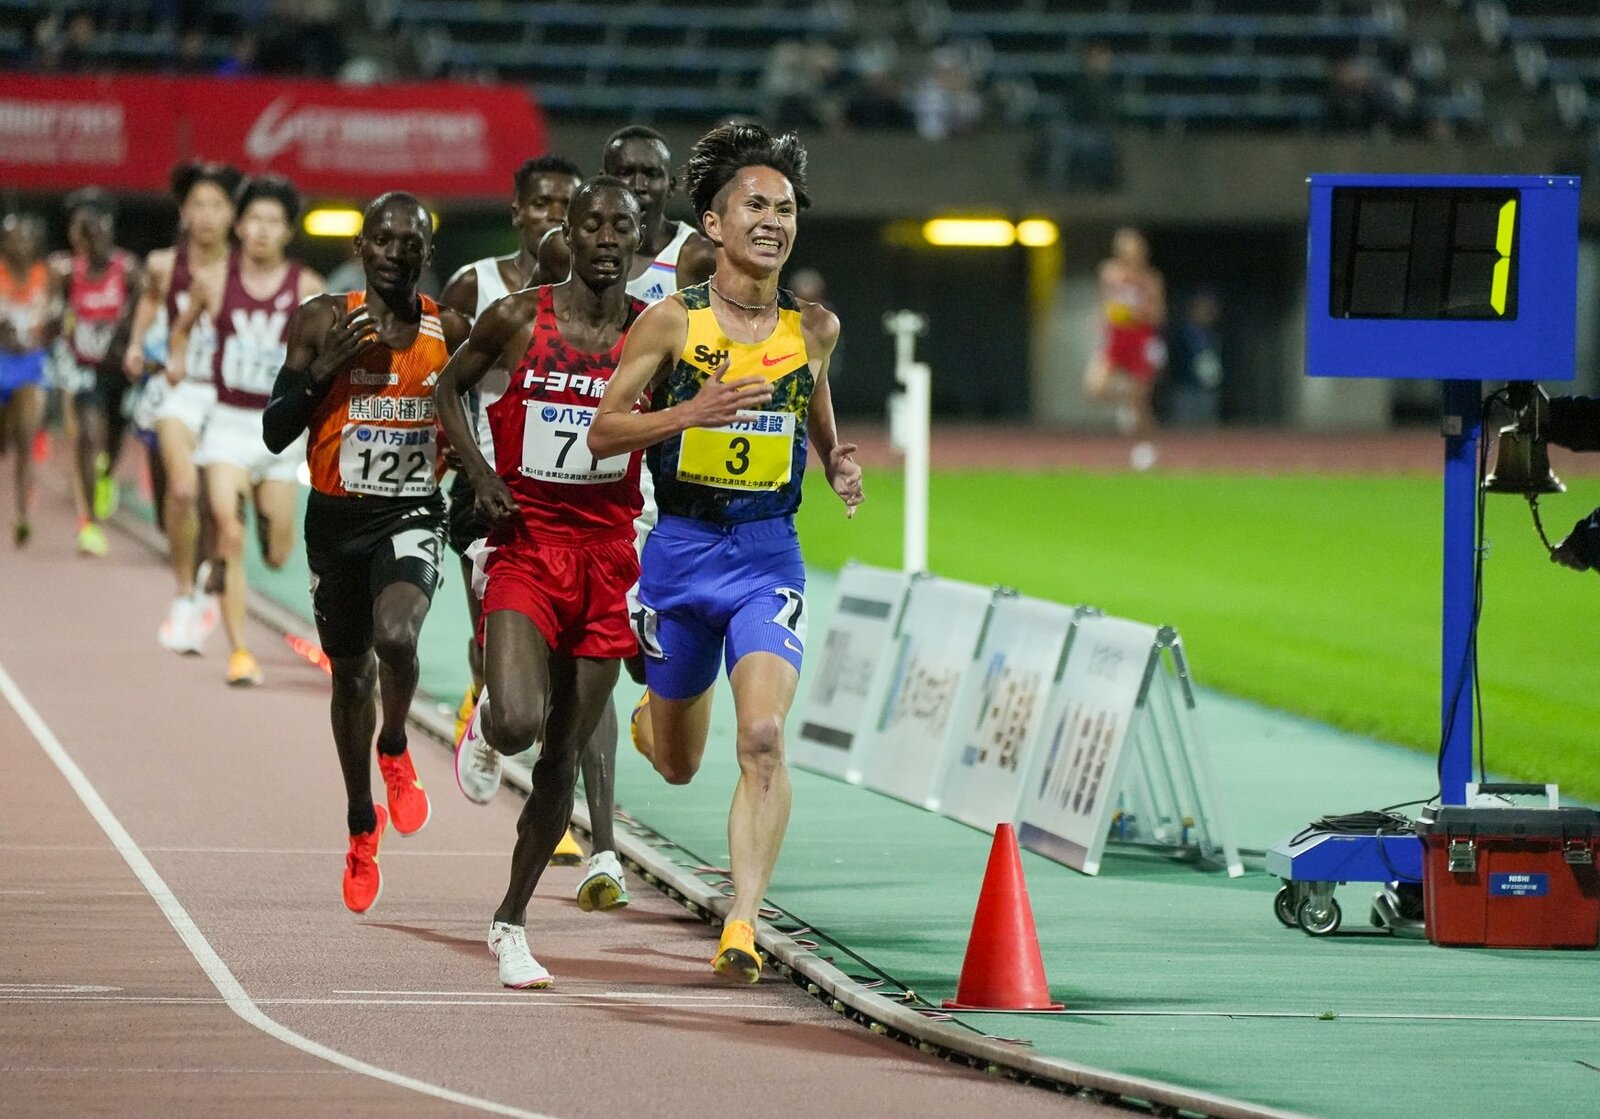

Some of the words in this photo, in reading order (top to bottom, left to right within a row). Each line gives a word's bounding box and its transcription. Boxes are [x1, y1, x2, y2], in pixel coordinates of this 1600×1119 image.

[1490, 199, 1517, 316] 1
[729, 414, 784, 433] 方建設
[373, 429, 430, 446] 八方建設
[358, 448, 426, 484] 122
[725, 436, 751, 476] 3
[1509, 875, 1530, 883] NISHI
